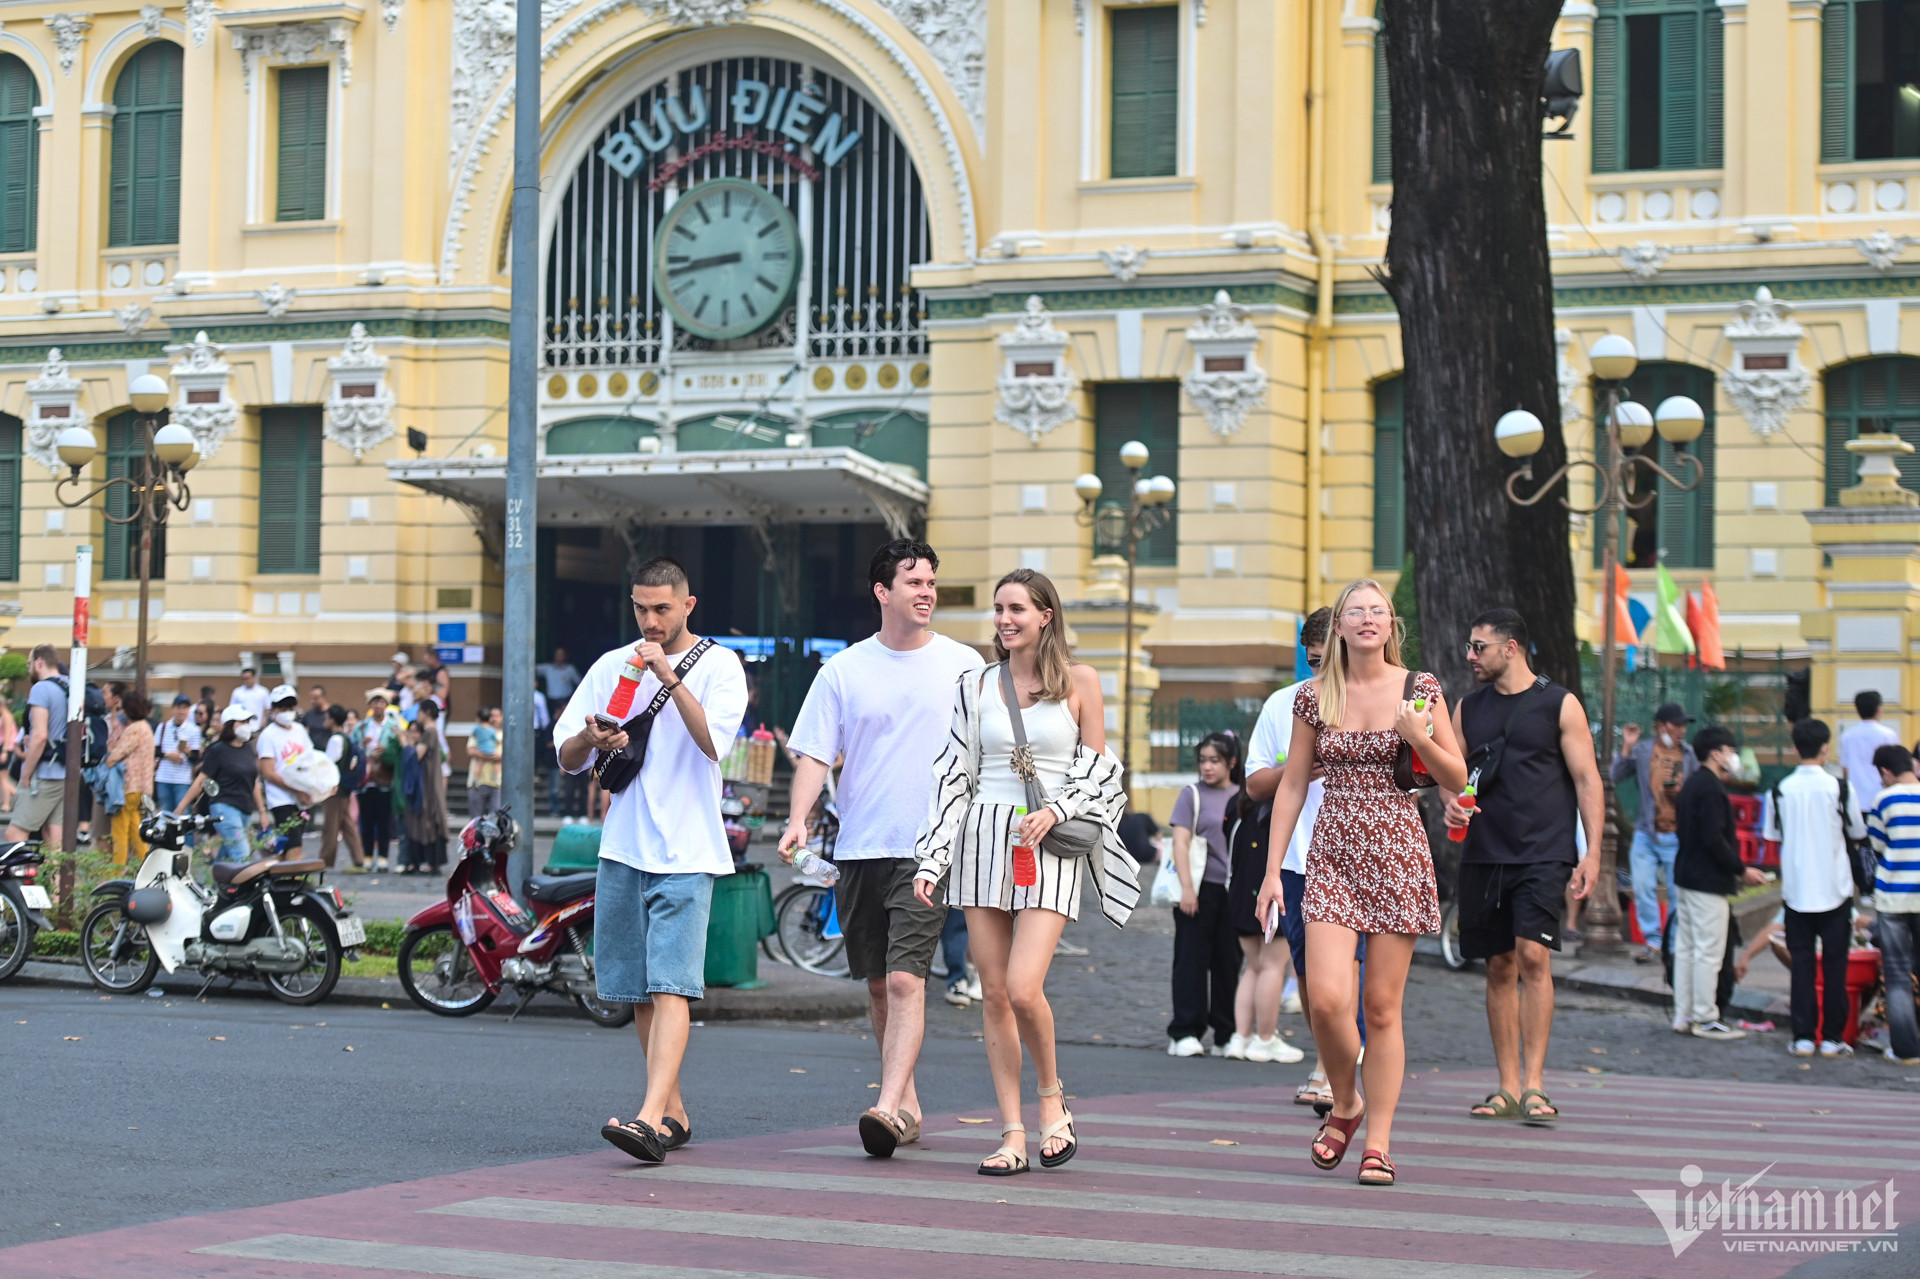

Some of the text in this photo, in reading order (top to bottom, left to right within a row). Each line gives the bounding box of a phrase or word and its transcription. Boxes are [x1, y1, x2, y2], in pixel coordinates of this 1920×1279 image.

[598, 79, 863, 179] BƯU ĐIỆN
[507, 499, 523, 514] CV
[508, 516, 521, 531] 31
[508, 533, 523, 548] 32
